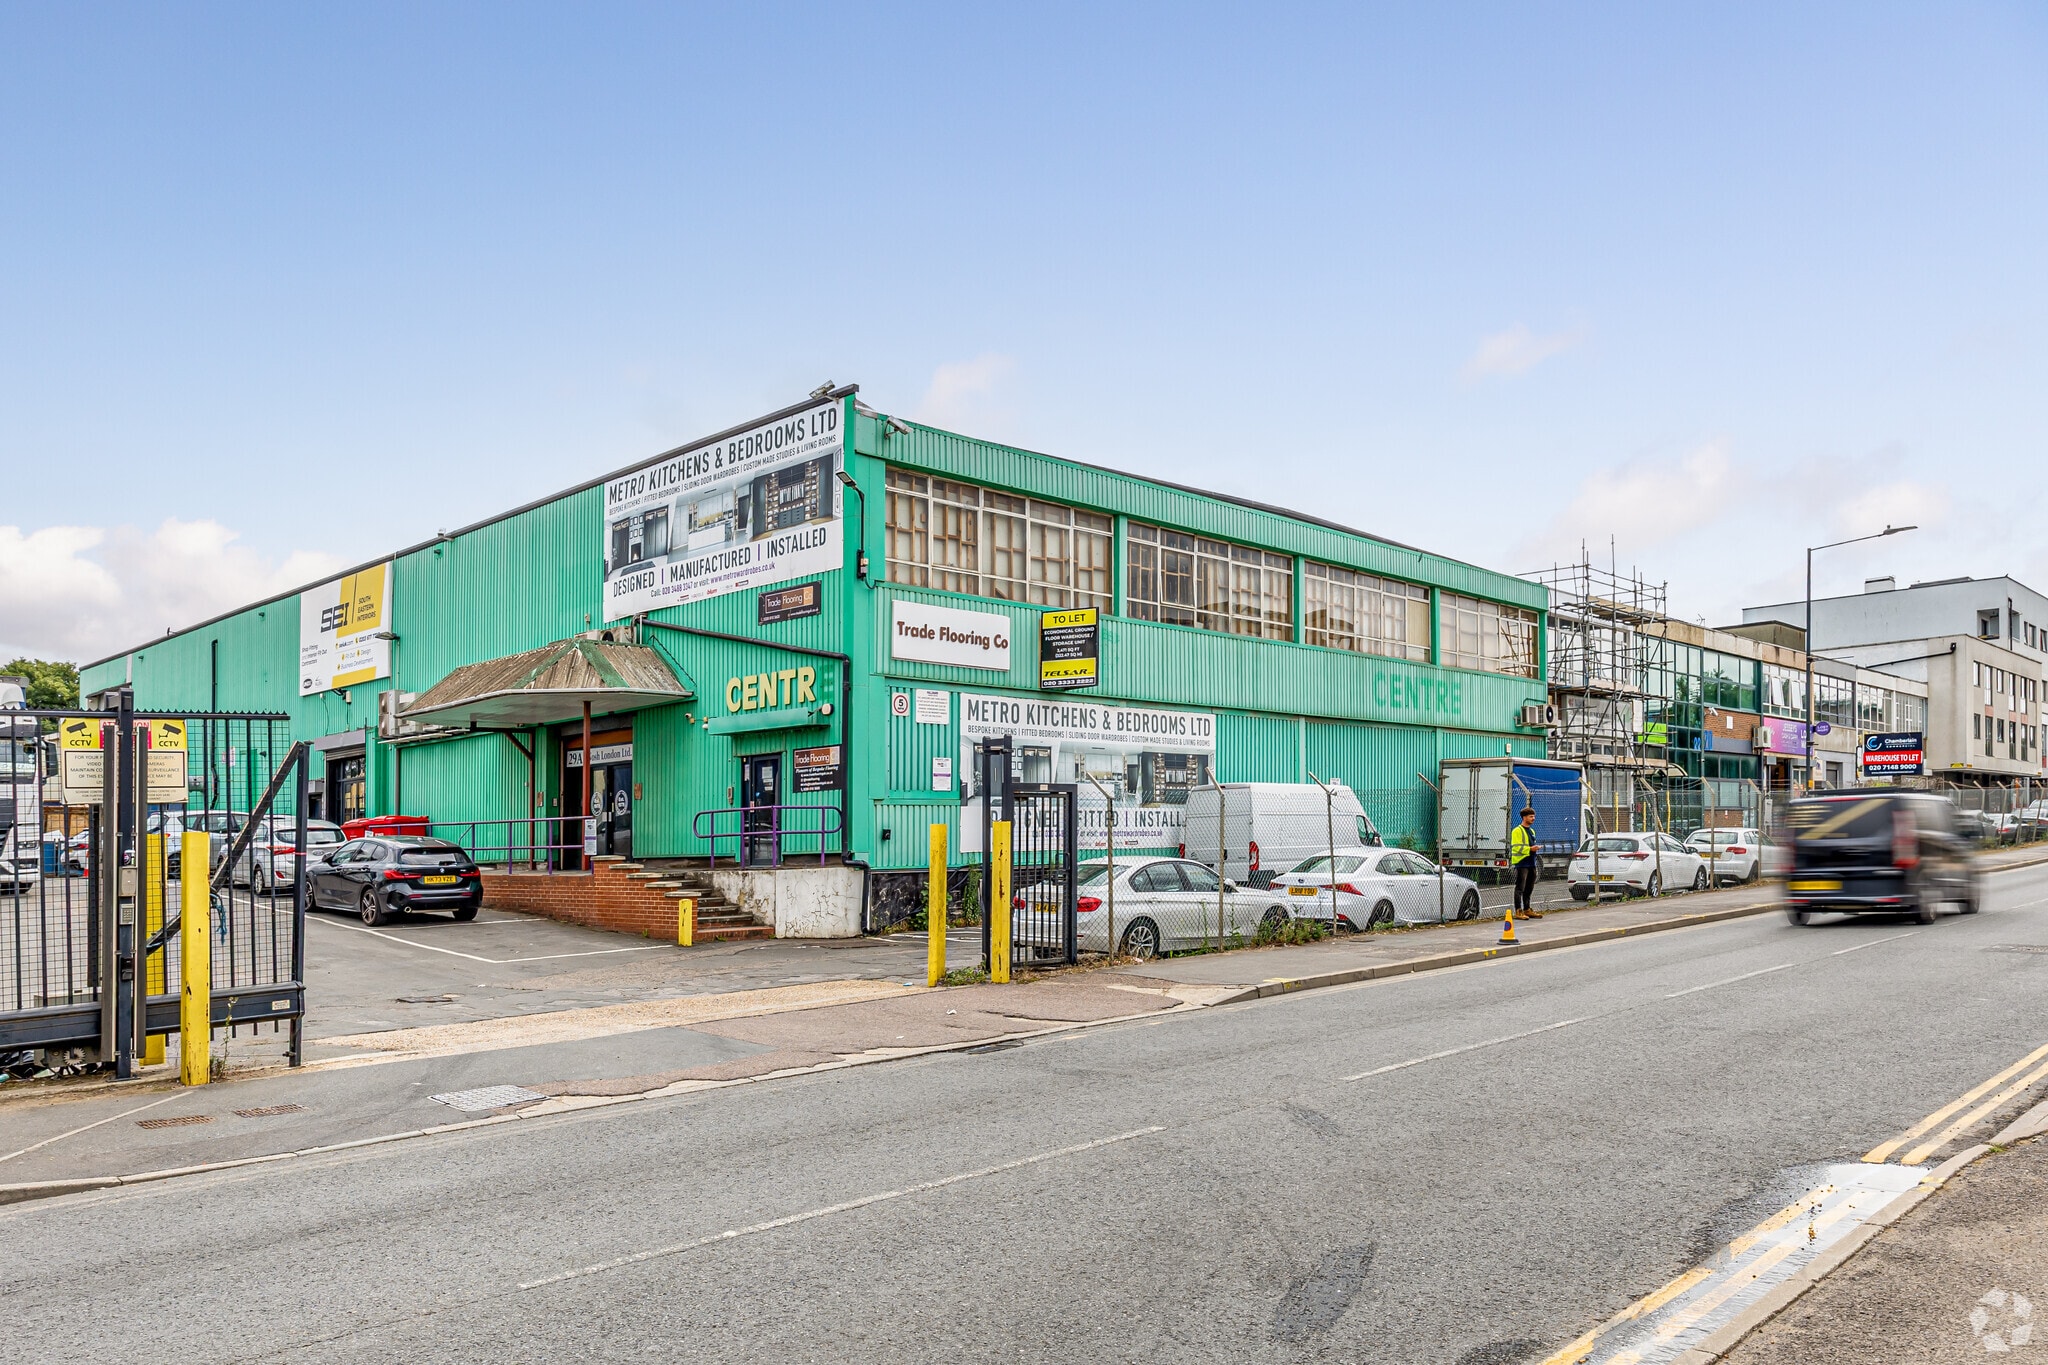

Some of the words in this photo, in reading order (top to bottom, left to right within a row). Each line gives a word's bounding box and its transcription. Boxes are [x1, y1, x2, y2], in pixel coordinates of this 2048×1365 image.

[609, 474, 645, 505] METRO
[649, 450, 710, 491] KITCHENS
[714, 449, 723, 469] &
[729, 418, 805, 464] BEDROOMS
[811, 407, 837, 436] LTD
[609, 504, 623, 516] BESPOKE
[623, 498, 641, 511] KITCHENS
[644, 493, 657, 503] FITTED
[658, 485, 681, 498] BEDROOMS
[684, 480, 700, 491] SLIDING
[700, 477, 712, 486] DOOR
[713, 466, 739, 481] WARDROBES
[743, 460, 761, 471] CUSTOM
[762, 456, 775, 465] MADE
[776, 447, 796, 460] STUDIES
[801, 440, 818, 452] LIVING
[818, 434, 836, 446] ROOMS
[613, 571, 655, 597] DESIGNED
[670, 546, 751, 582] MANUFACTURED
[767, 527, 826, 558] INSTALLED
[651, 589, 661, 597] Call:
[662, 586, 670, 595] 020
[699, 578, 710, 587] visit:
[710, 561, 776, 584] www.metrowardrobes.co.uk
[358, 595, 371, 604] SOUTH
[767, 596, 781, 607] Trade
[782, 594, 803, 605] Flooring
[357, 611, 377, 621] INTERIORS
[358, 604, 374, 613] EASTERN
[320, 602, 349, 633] SEI
[1053, 615, 1066, 624] TO
[1069, 613, 1086, 623] LET
[897, 621, 936, 640] Trade
[939, 626, 990, 650] Flooring
[993, 634, 1009, 649] Co
[1044, 668, 1088, 677] TELSAR
[1374, 670, 1461, 715] CENTRE
[898, 698, 904, 706] 5
[968, 699, 1020, 724] METRO
[1026, 703, 1097, 729] KITCHENS
[1102, 710, 1111, 730] &
[1117, 711, 1187, 736] BEDROOMS
[1191, 716, 1211, 737] LTD
[70, 739, 92, 747] CCTV
[968, 725, 992, 735] BESPOKE
[992, 727, 1017, 737] KITCHENS
[1021, 728, 1038, 738] FITTED
[1039, 730, 1065, 739] BEDROOMS
[1068, 731, 1087, 740] SLIDING
[1088, 732, 1100, 740] DOOR
[1101, 733, 1128, 743] WARDROBES
[1131, 735, 1149, 744] CUSTOM
[1149, 736, 1162, 745] MADE
[1162, 737, 1179, 746] STUDIES
[1183, 739, 1196, 747] LIVING
[1196, 739, 1211, 747] ROOMS
[159, 740, 179, 748] CCTV
[568, 752, 583, 765] 29A
[601, 748, 621, 760] London
[622, 746, 633, 758] Ltd.
[795, 753, 810, 764] Trade
[810, 753, 830, 763] Flooring
[1908, 753, 1919, 761] LET
[1135, 810, 1185, 828] INSTALL
